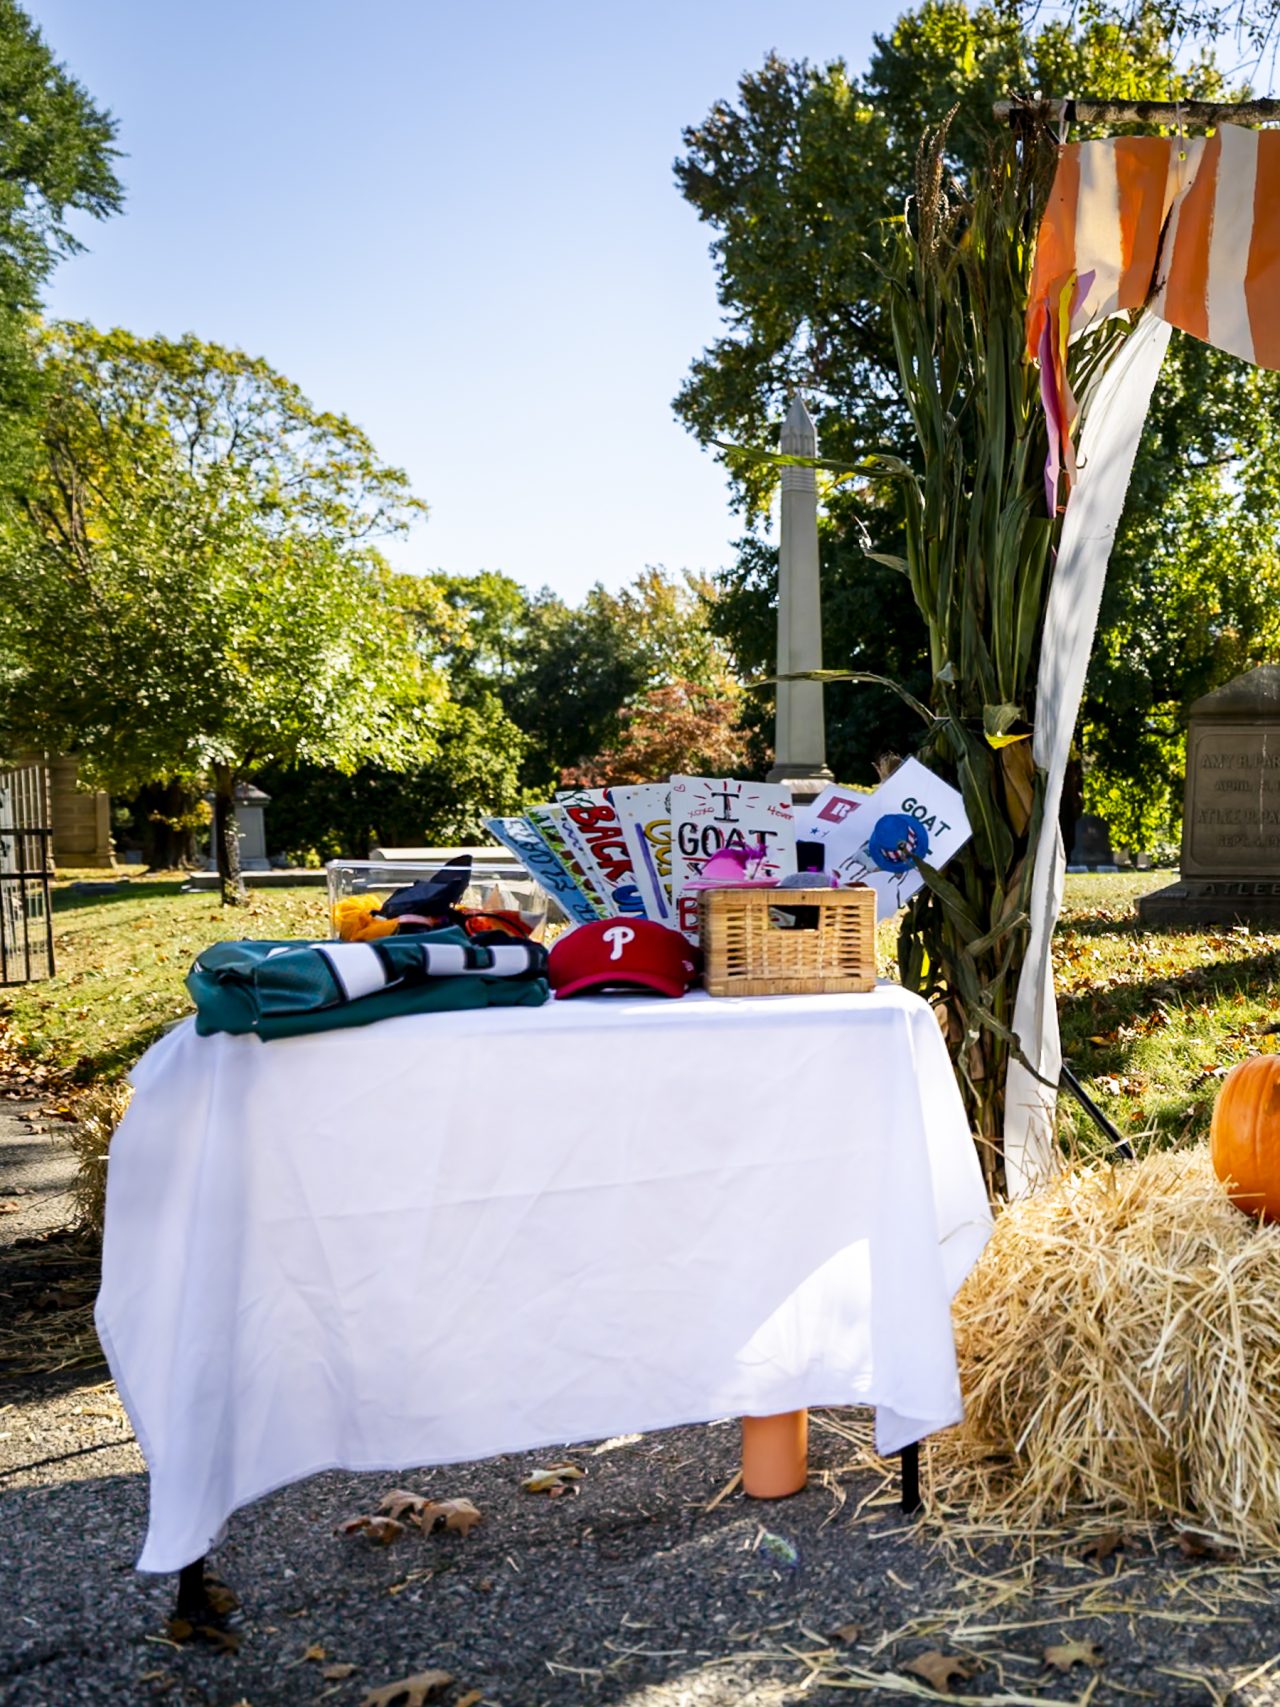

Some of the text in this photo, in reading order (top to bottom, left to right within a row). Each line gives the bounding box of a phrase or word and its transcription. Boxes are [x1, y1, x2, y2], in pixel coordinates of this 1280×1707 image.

[711, 792, 739, 823] I
[901, 797, 952, 837] GOAT
[678, 821, 778, 858] GOAT
[602, 926, 635, 960] P
